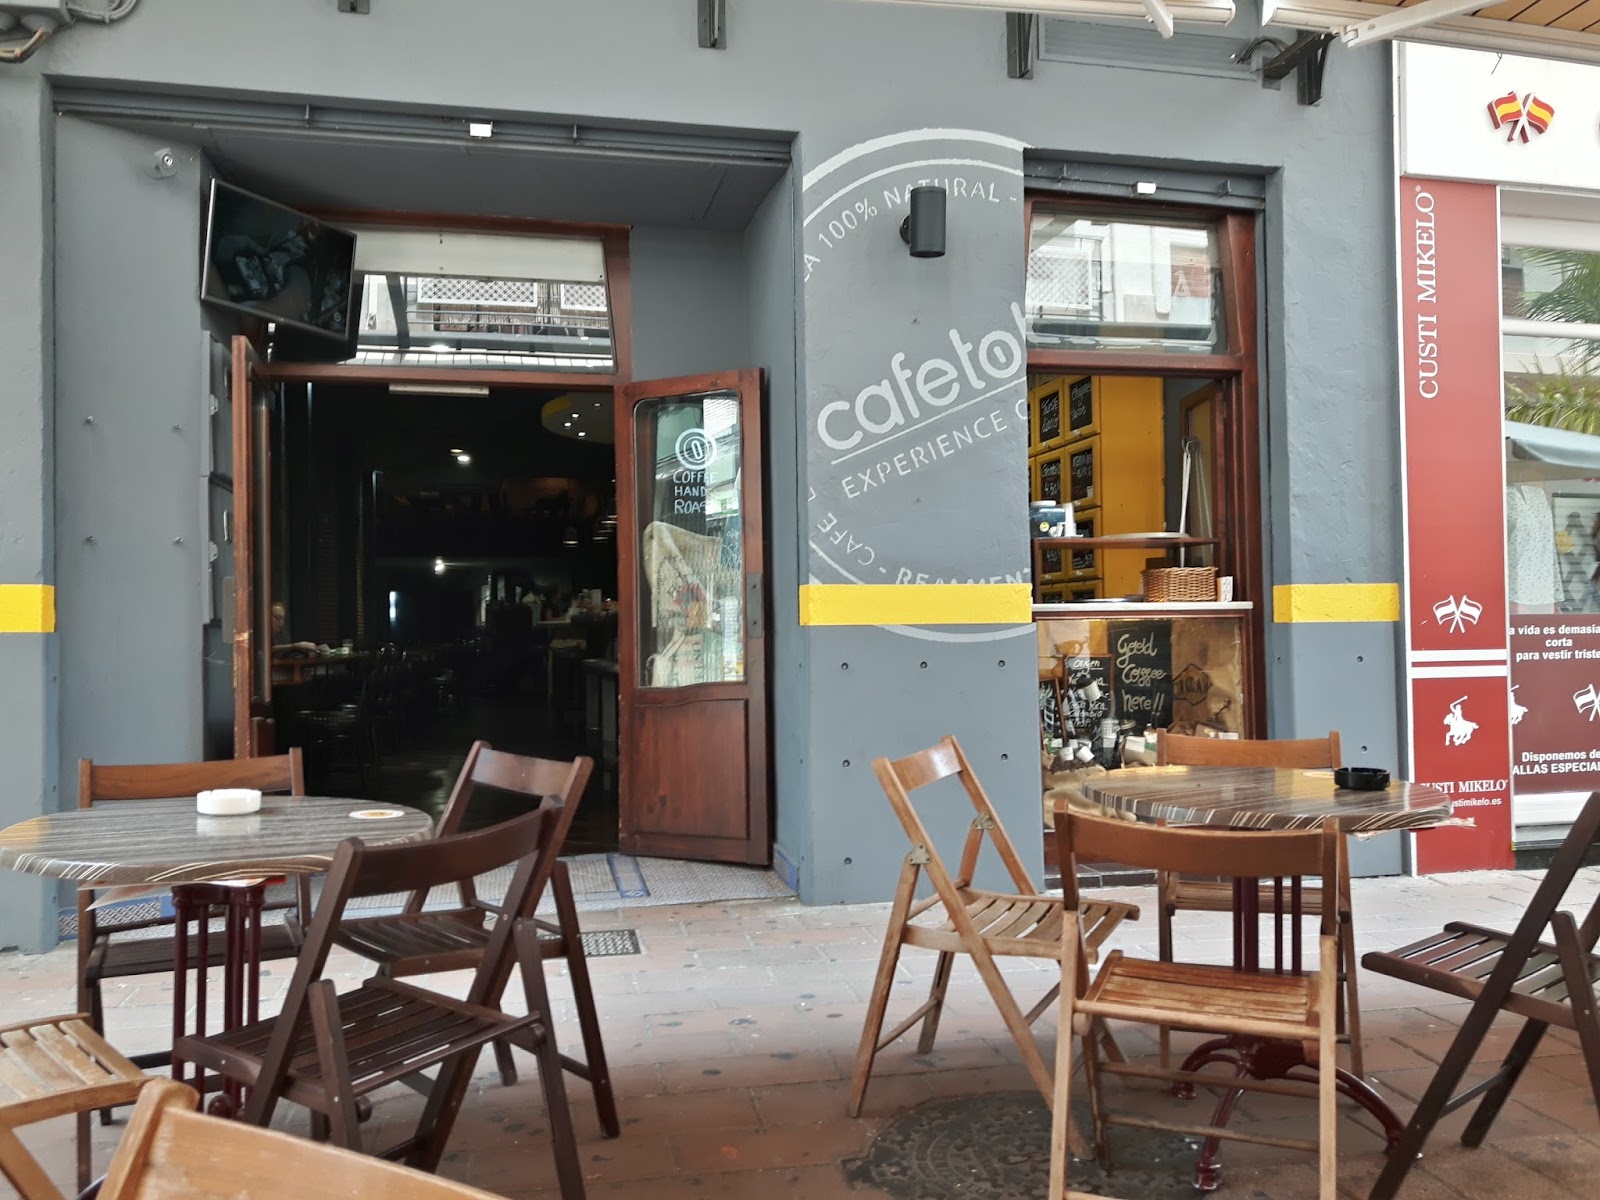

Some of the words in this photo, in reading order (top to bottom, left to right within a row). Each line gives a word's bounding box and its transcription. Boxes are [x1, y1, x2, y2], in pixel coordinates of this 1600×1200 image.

[818, 198, 877, 248] 100%
[1418, 313, 1439, 399] CUSTI
[841, 410, 1008, 499] EXPERIENCE
[816, 512, 875, 566] CAFE
[1518, 625, 1540, 635] vida
[1543, 626, 1556, 635] es
[1545, 637, 1573, 647] corta
[1116, 632, 1157, 668] Good
[1516, 652, 1540, 663] para
[1542, 649, 1573, 660] vestir
[1521, 751, 1587, 764] Disponemos
[1512, 764, 1548, 775] ALLAS
[1419, 781, 1455, 794] STI
